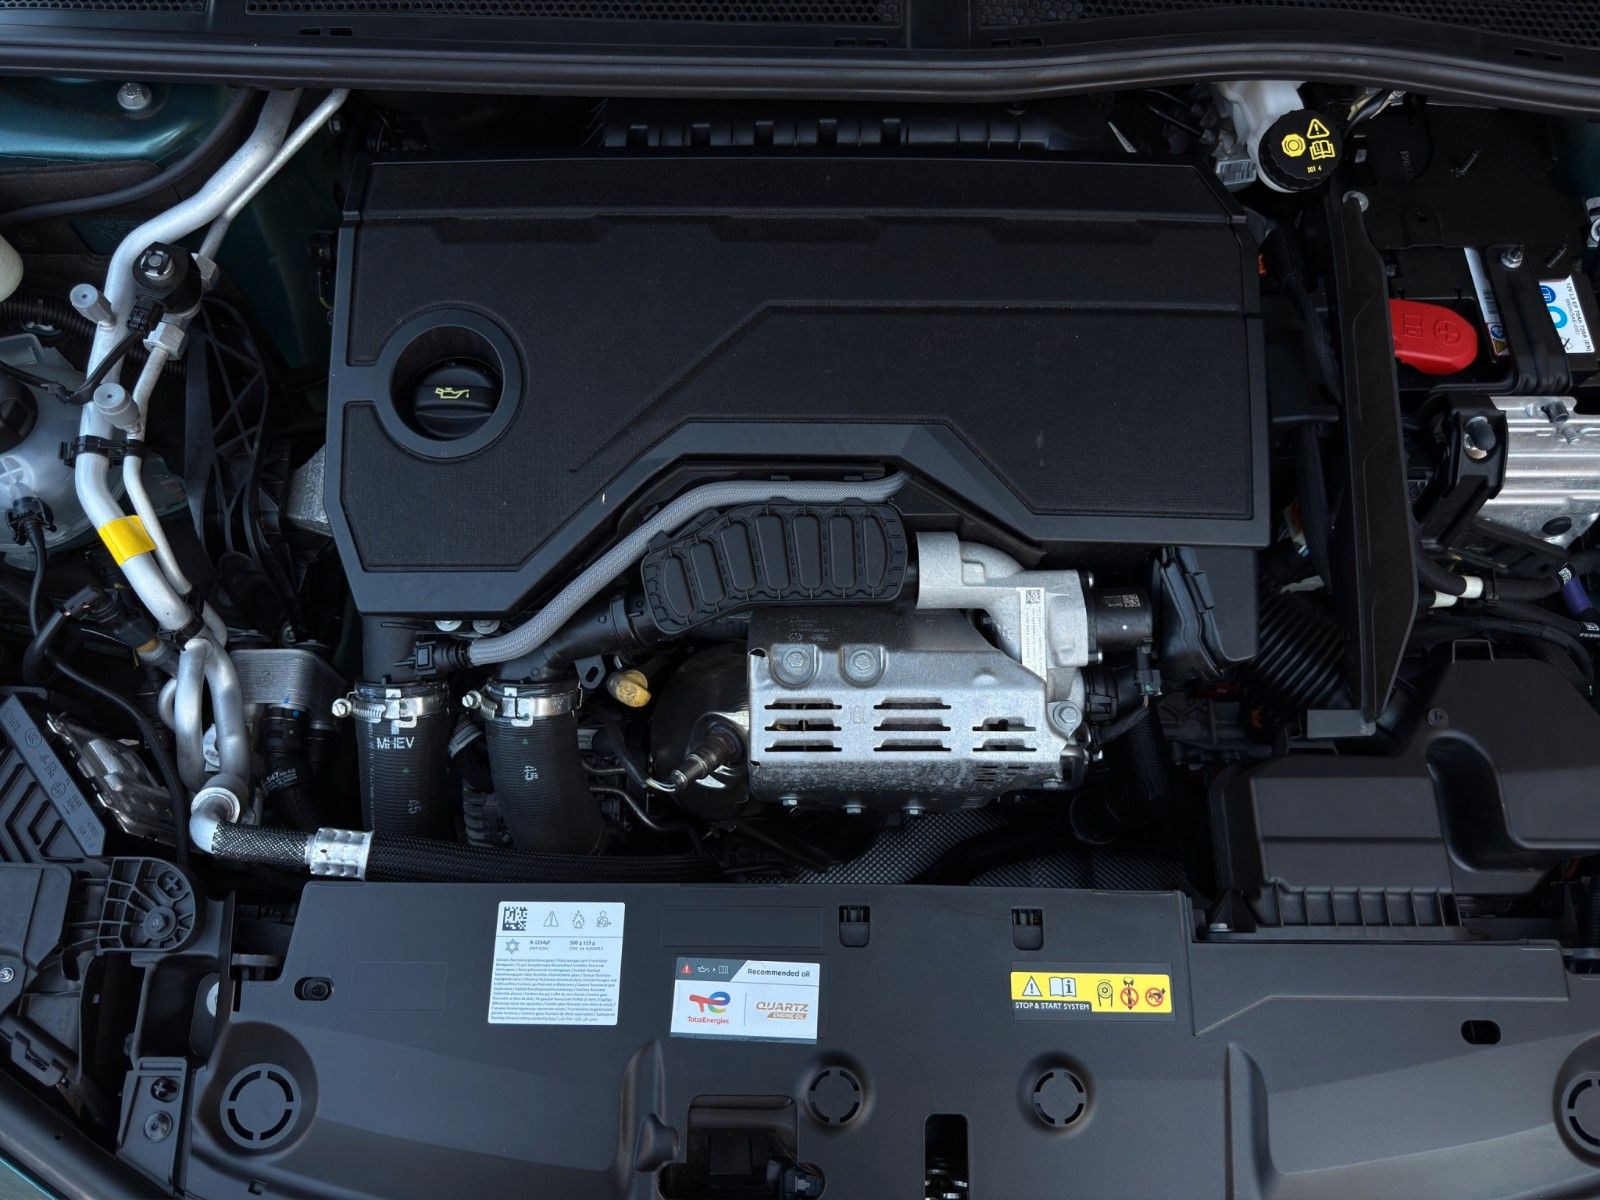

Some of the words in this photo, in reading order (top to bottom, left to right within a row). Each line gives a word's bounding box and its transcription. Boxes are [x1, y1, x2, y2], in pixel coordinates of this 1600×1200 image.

[748, 969, 799, 977] Recommended
[756, 1001, 808, 1012] QUARTZ
[688, 1016, 730, 1024] TotalEnergies
